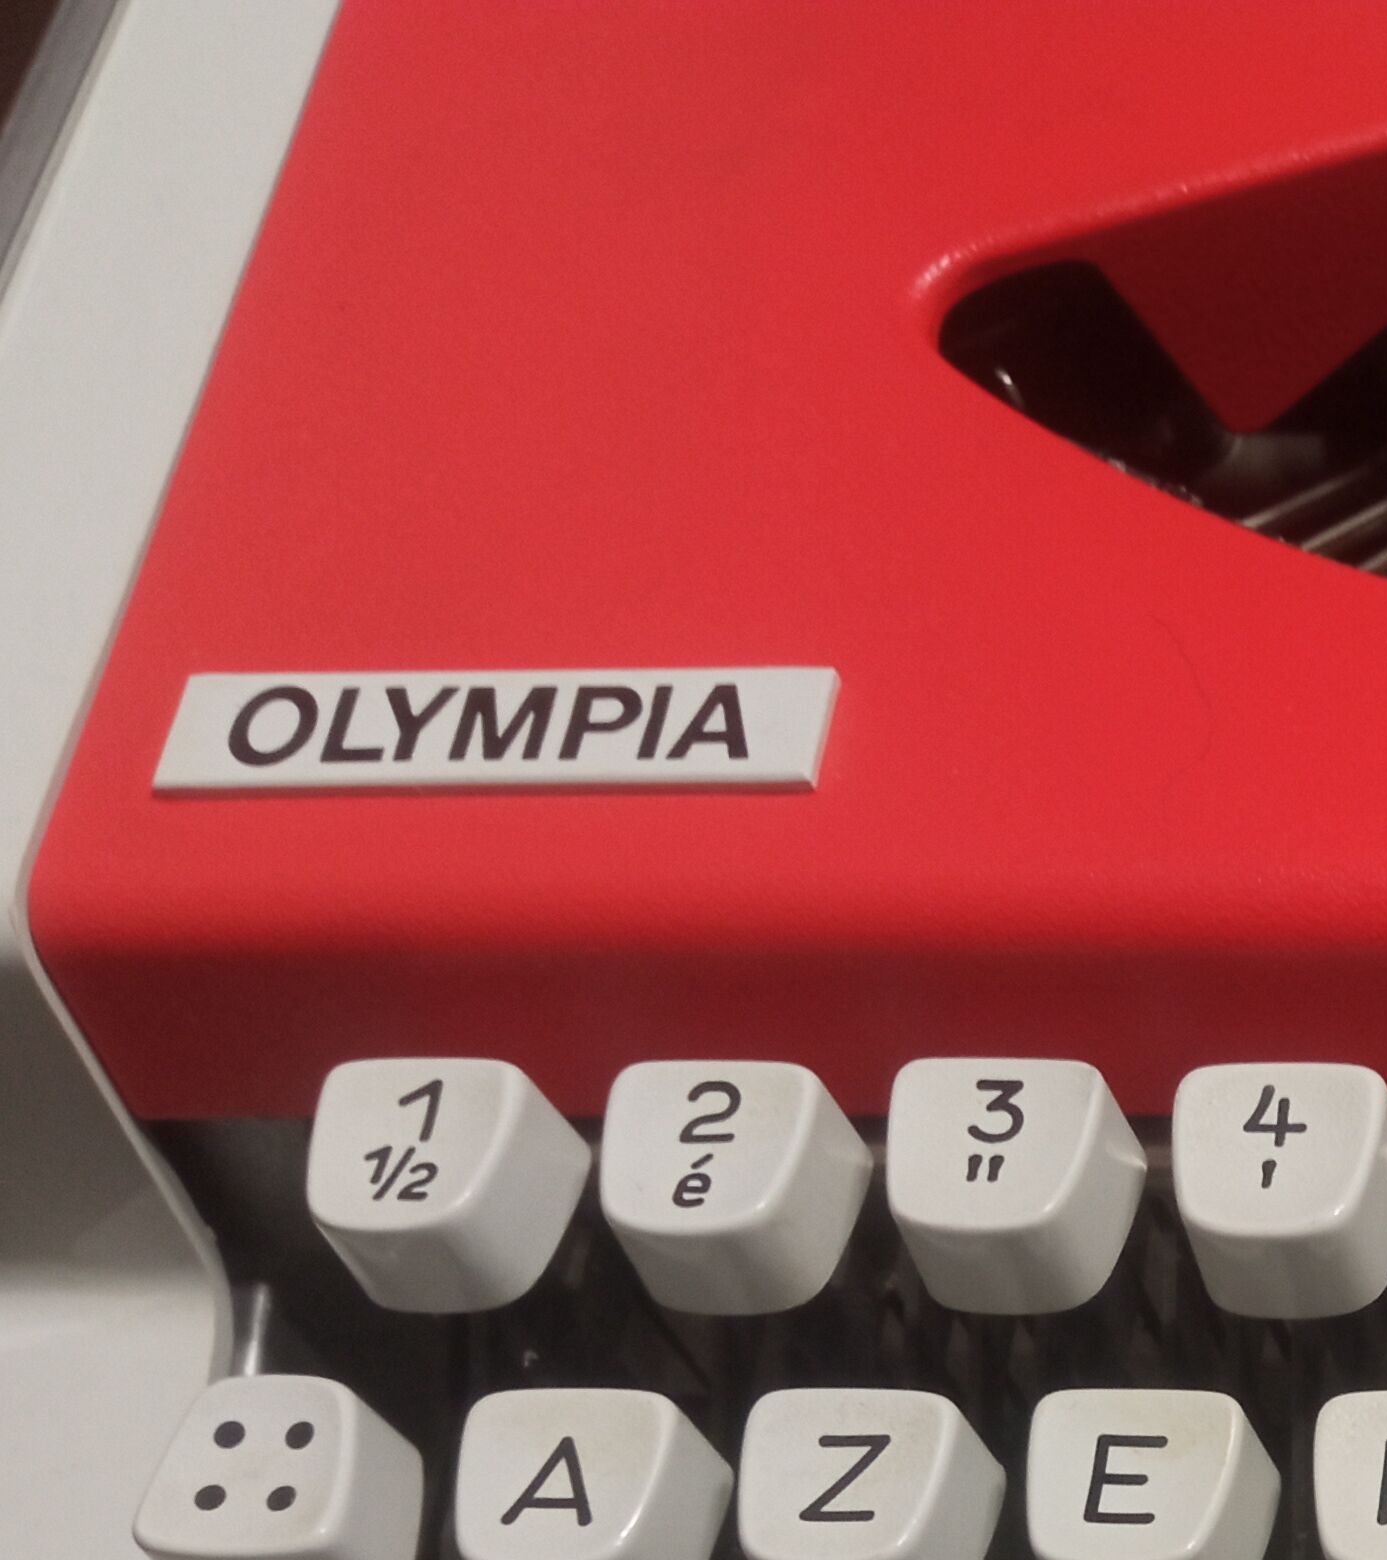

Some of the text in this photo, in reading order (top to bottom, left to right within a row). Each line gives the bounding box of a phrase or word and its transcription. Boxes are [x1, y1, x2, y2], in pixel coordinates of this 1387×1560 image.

[226, 682, 750, 768] OLYMPIA
[396, 1077, 445, 1144] 1
[678, 1079, 743, 1146] 2
[966, 1078, 1026, 1145] 3
[1241, 1083, 1309, 1149] 4
[670, 1152, 715, 1210] é
[499, 1434, 594, 1528] A
[797, 1433, 893, 1524] Z
[1082, 1432, 1170, 1526] E
